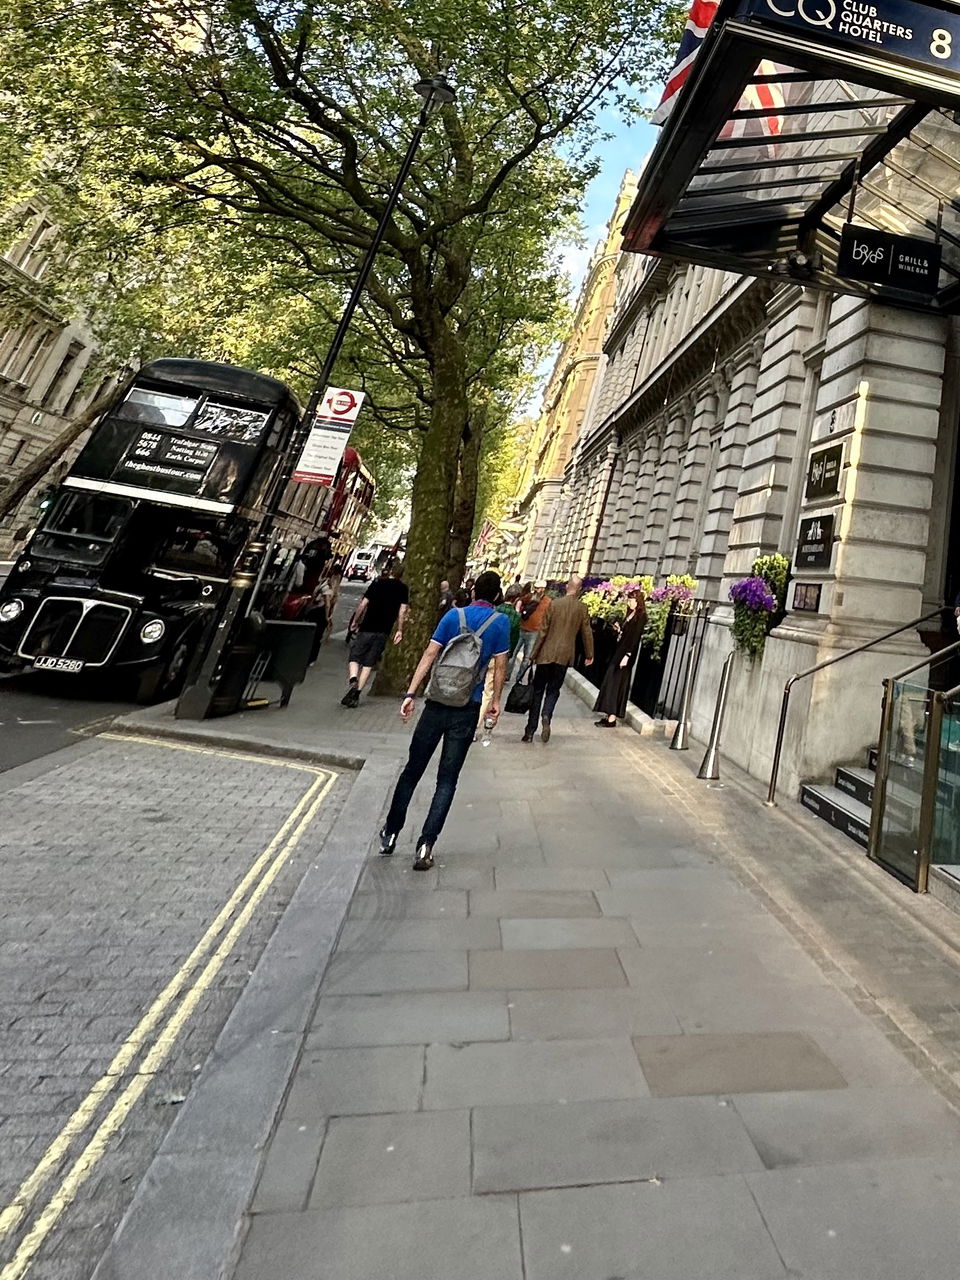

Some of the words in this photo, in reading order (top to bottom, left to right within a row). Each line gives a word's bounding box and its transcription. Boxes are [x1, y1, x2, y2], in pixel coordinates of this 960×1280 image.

[843, 0, 877, 17] CLUB
[838, 21, 883, 44] HOTEL
[841, 11, 913, 40] QUARTERS
[929, 28, 953, 59] 8
[898, 264, 915, 273] WINE
[916, 267, 929, 275] BAR
[137, 439, 158, 449] 5678
[170, 437, 199, 448] Trafalgar
[135, 448, 151, 457] 666
[170, 445, 194, 456] Notting
[124, 460, 202, 480] theghostbustour.com
